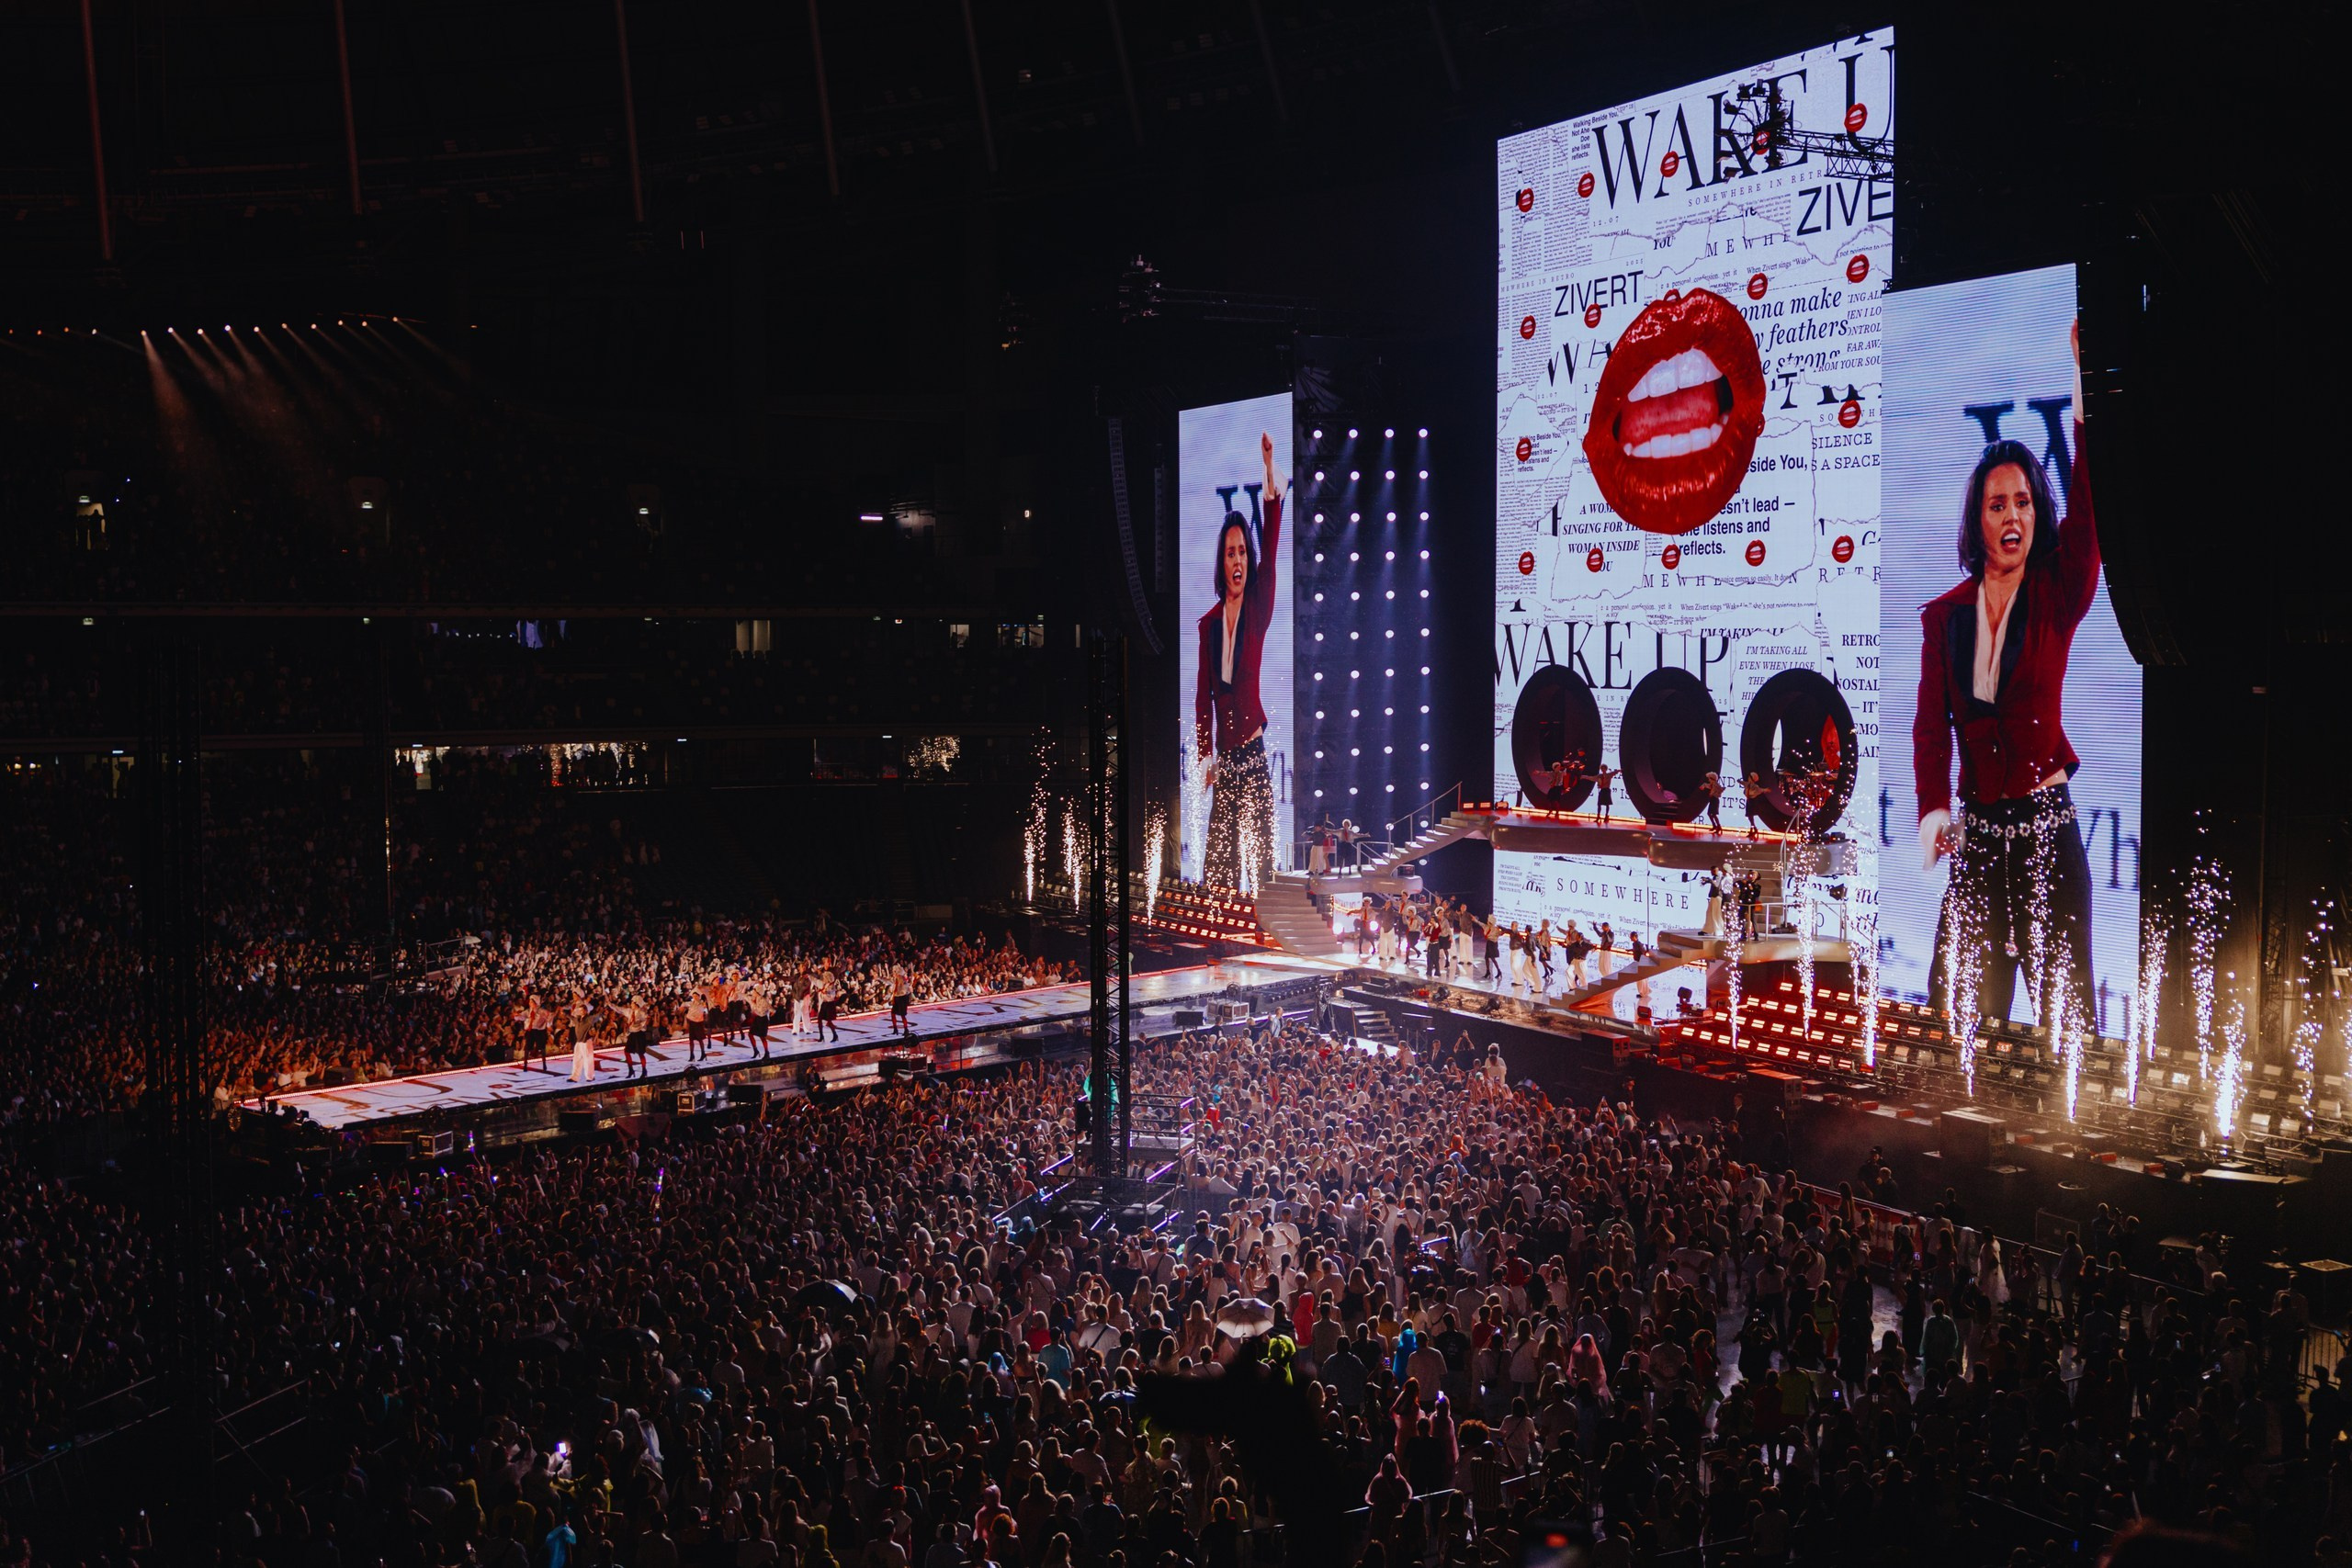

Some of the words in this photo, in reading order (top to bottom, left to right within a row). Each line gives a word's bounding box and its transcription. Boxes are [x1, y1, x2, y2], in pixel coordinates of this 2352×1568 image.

[1572, 118, 1591, 129] Walking
[1592, 113, 1608, 124] Beside
[1608, 111, 1619, 119] You,
[1591, 68, 1808, 210] WAKE
[1571, 151, 1589, 161] reflects.
[1688, 183, 1761, 207] SOMEWHERE
[1770, 178, 1782, 189] IN
[1797, 177, 1894, 237] ZIVE
[1747, 265, 1761, 274] When
[1762, 262, 1779, 272] Zivert
[1779, 260, 1792, 270] sings
[1672, 277, 1691, 288] personal
[1555, 270, 1644, 317] ZIVERT
[1848, 292, 1866, 304] ING
[1734, 300, 1784, 321] onna
[1790, 286, 1842, 315] make
[1765, 318, 1849, 353] feathers
[1847, 341, 1863, 353] FAR
[1839, 357, 1863, 370] YOUR
[1536, 433, 1551, 441] Beside
[1552, 432, 1562, 440] You,
[1812, 433, 1872, 450] SILENCE
[1780, 455, 1808, 471] You,
[1821, 460, 1831, 471] A
[1834, 454, 1881, 470] SPACE
[1579, 504, 1587, 514] A
[1753, 495, 1779, 513] lead
[1563, 522, 1601, 535] SINGING
[1603, 521, 1623, 533] FOR
[1702, 521, 1743, 536] listens
[1747, 516, 1770, 533] and
[1606, 540, 1640, 553] INSIDE
[1679, 539, 1726, 557] reflects.
[1758, 573, 1774, 583] easily.
[1611, 604, 1629, 612] personal
[1694, 603, 1709, 611] Zivert
[1710, 603, 1722, 612] sings
[1495, 621, 1632, 689] WAKE
[1746, 647, 1758, 655] I’M
[1759, 646, 1791, 655] TAKING
[1792, 646, 1808, 655] ALL
[1739, 661, 1761, 671] EVEN
[1762, 660, 1784, 671] WHEN
[1748, 676, 1765, 685] THE
[1722, 796, 1746, 810] IT’S
[1556, 877, 1689, 909] SOMEWHERE
